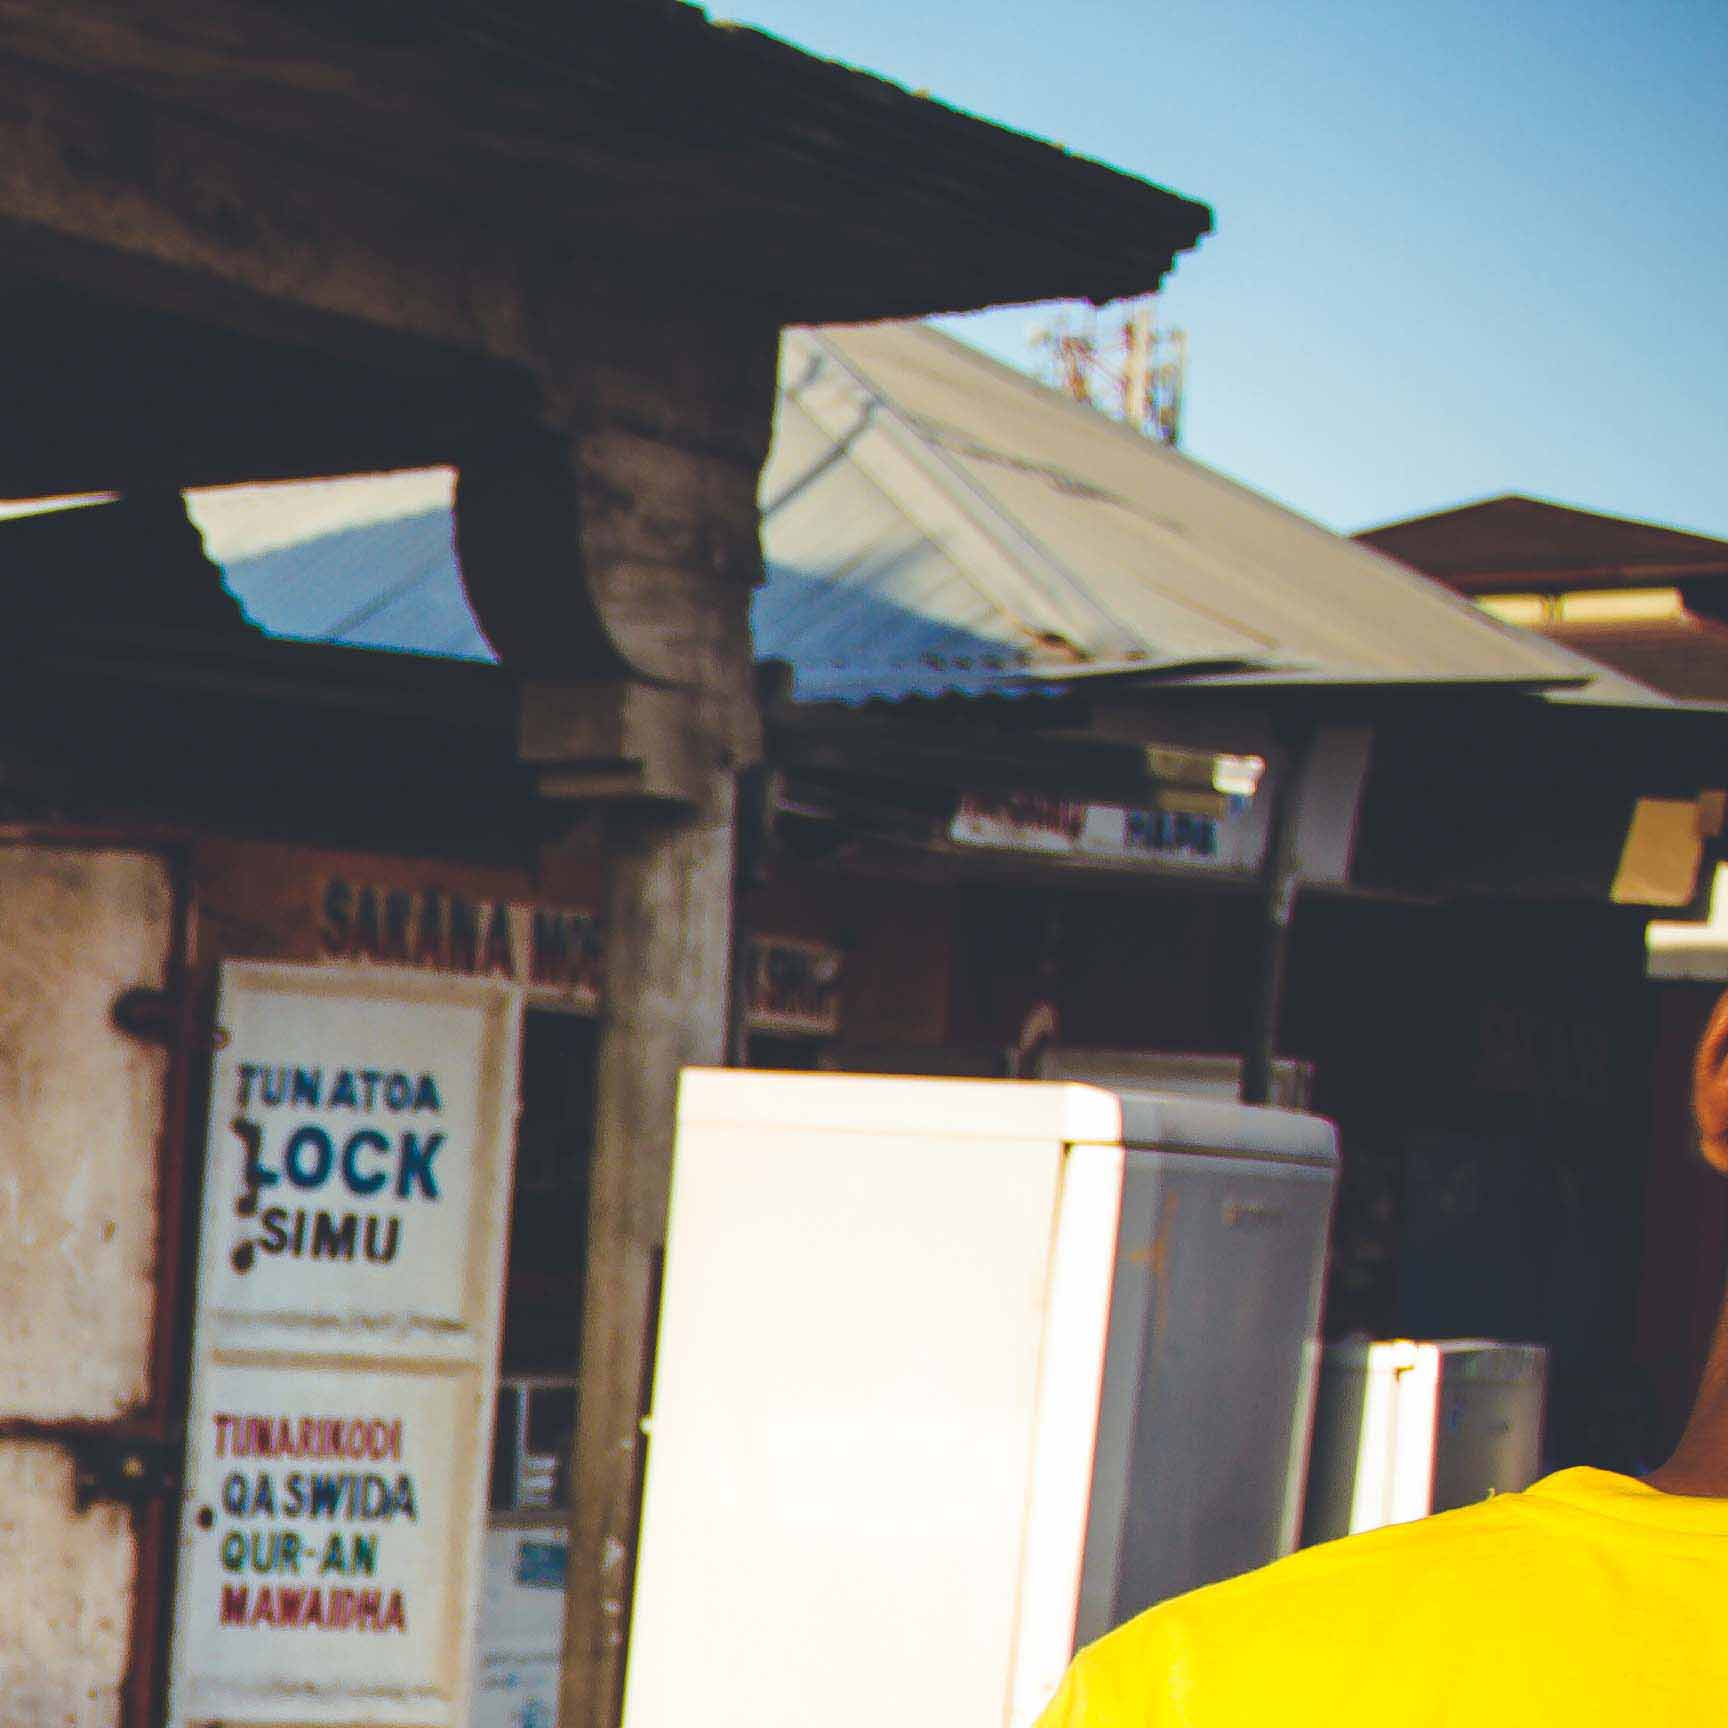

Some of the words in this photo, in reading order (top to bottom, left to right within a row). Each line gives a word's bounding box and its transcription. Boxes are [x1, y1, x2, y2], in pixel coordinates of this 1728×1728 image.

[237, 1063, 443, 1112] TUNATOA
[247, 1124, 446, 1201] LOCK
[257, 1206, 401, 1264] SIMU
[221, 1529, 379, 1577] QUR-AN
[218, 1582, 407, 1633] MAWAIDHA
